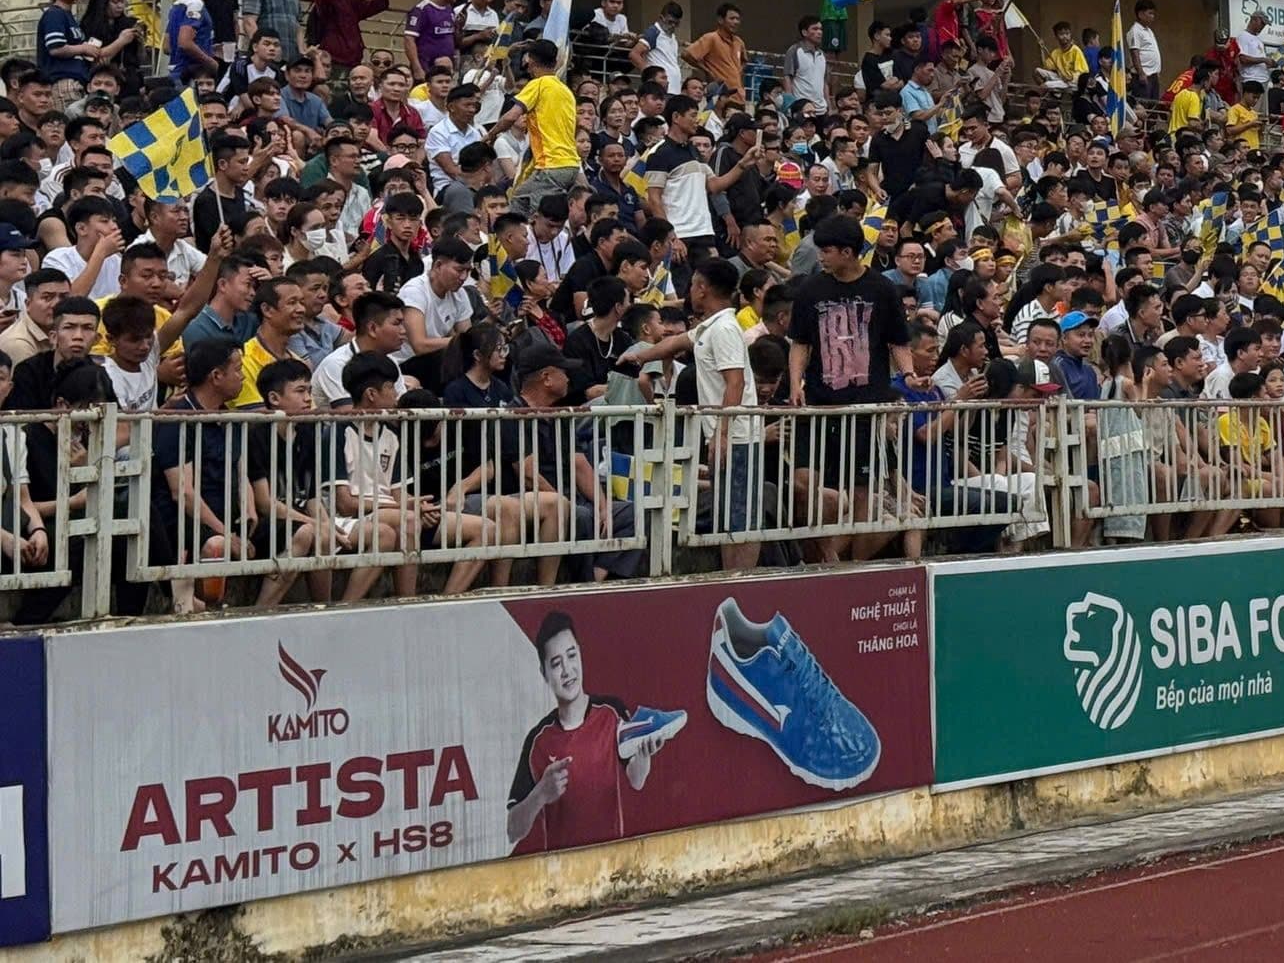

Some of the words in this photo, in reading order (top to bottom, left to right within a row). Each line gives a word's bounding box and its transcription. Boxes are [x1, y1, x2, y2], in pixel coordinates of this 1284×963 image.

[851, 601, 880, 621] NGHỆ
[883, 597, 917, 617] THUẬT
[857, 635, 893, 653] THĂNG
[896, 633, 919, 649] HOA
[1150, 600, 1242, 670] SIBA
[1156, 679, 1185, 713] Bếp
[1188, 679, 1214, 705] của
[1218, 674, 1244, 704] mọi
[1247, 670, 1273, 697] nhà
[268, 707, 349, 742] KAMITO
[120, 744, 480, 852] ARTISTA
[152, 842, 320, 893] KAMITO
[337, 841, 358, 864] x
[373, 821, 453, 857] HS8
